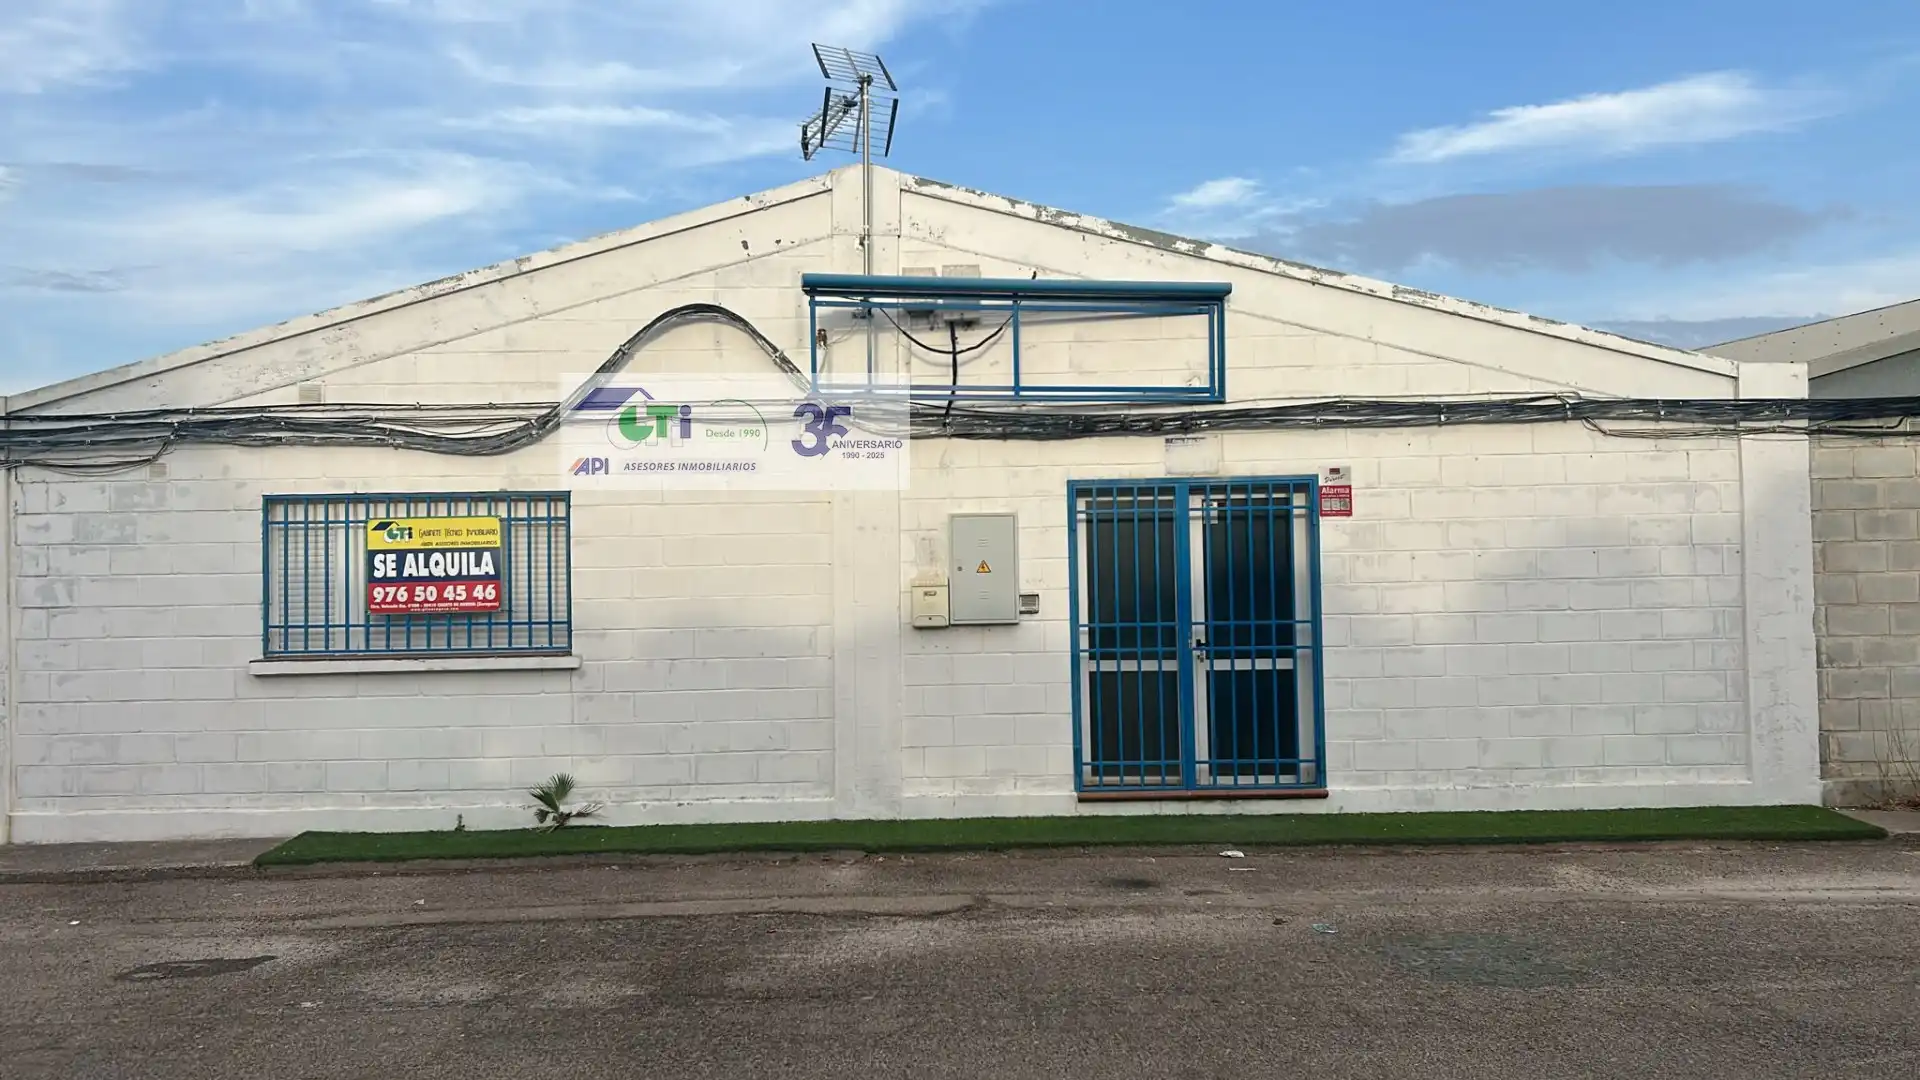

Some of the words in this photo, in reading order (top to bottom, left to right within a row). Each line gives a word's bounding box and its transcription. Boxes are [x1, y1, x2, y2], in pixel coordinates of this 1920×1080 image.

[373, 553, 397, 578] SE
[402, 551, 496, 577] ALQUILA
[373, 586, 408, 603] 976
[413, 585, 438, 602] 50
[443, 584, 467, 601] 45
[472, 584, 496, 600] 46
